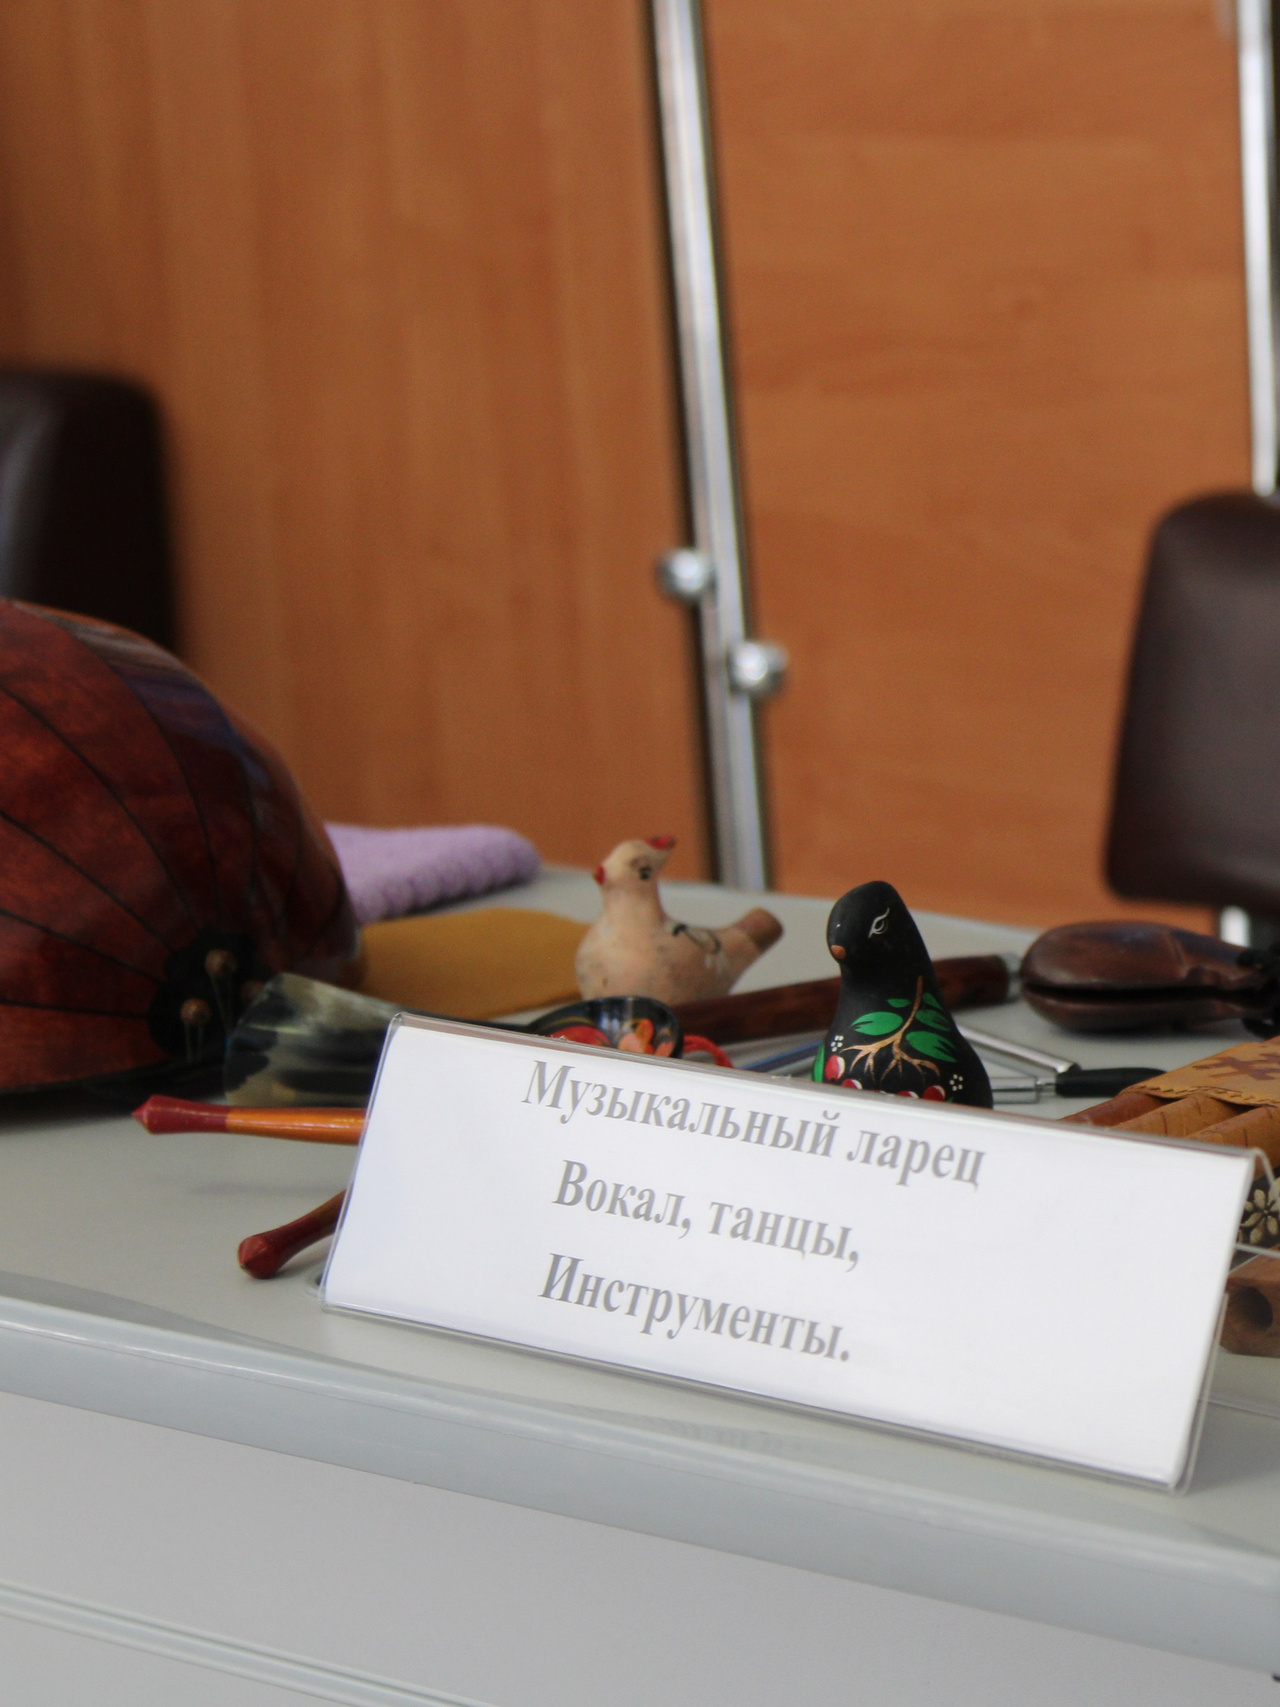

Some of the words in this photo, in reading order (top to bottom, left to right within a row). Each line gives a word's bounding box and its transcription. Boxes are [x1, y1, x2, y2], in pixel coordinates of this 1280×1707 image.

[521, 1059, 840, 1159] Музыкальный
[846, 1128, 986, 1191] ларец
[552, 1159, 692, 1239] Вокал,
[707, 1199, 861, 1273] танцы,
[537, 1252, 851, 1362] Инструменты.
